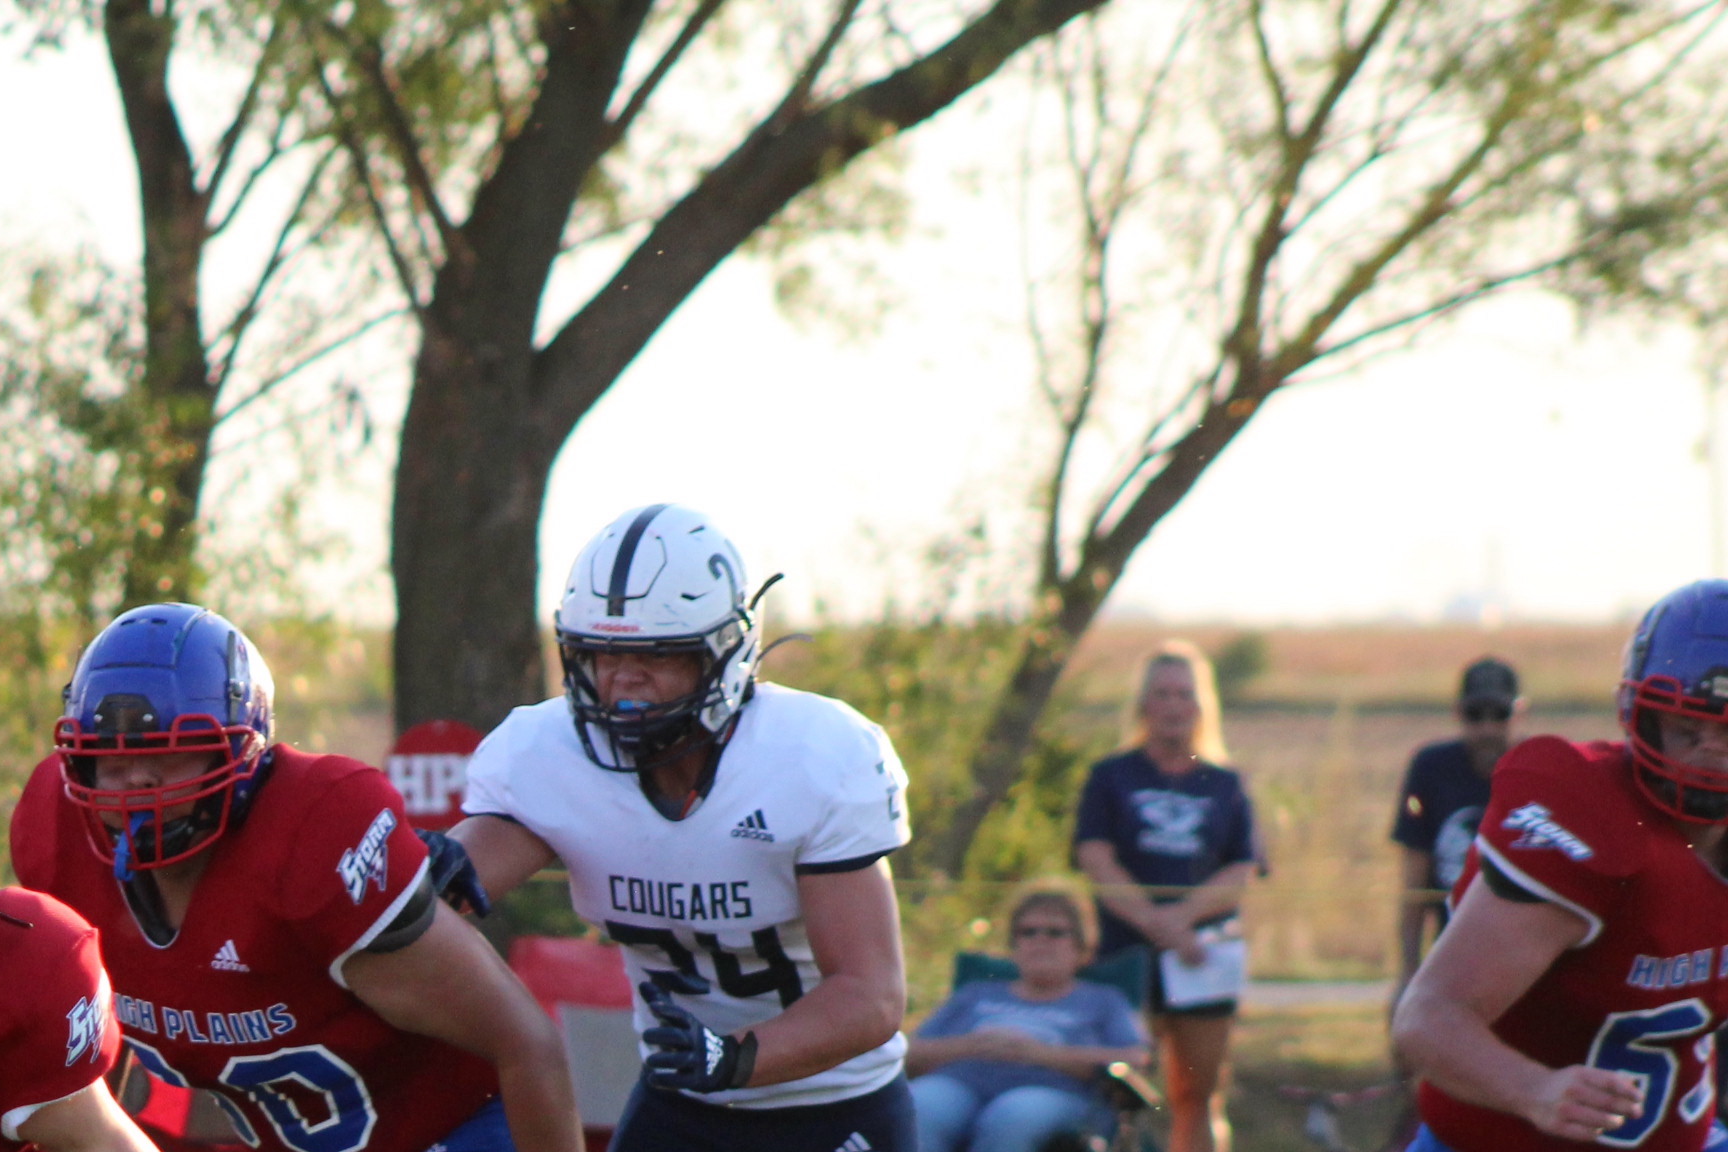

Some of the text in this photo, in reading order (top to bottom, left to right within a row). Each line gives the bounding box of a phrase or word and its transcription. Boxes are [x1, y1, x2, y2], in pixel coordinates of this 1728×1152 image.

[730, 827, 775, 843] adidas
[608, 874, 753, 921] COUGARS
[1625, 947, 1715, 990] HIGH
[161, 1002, 297, 1045] PLAINS
